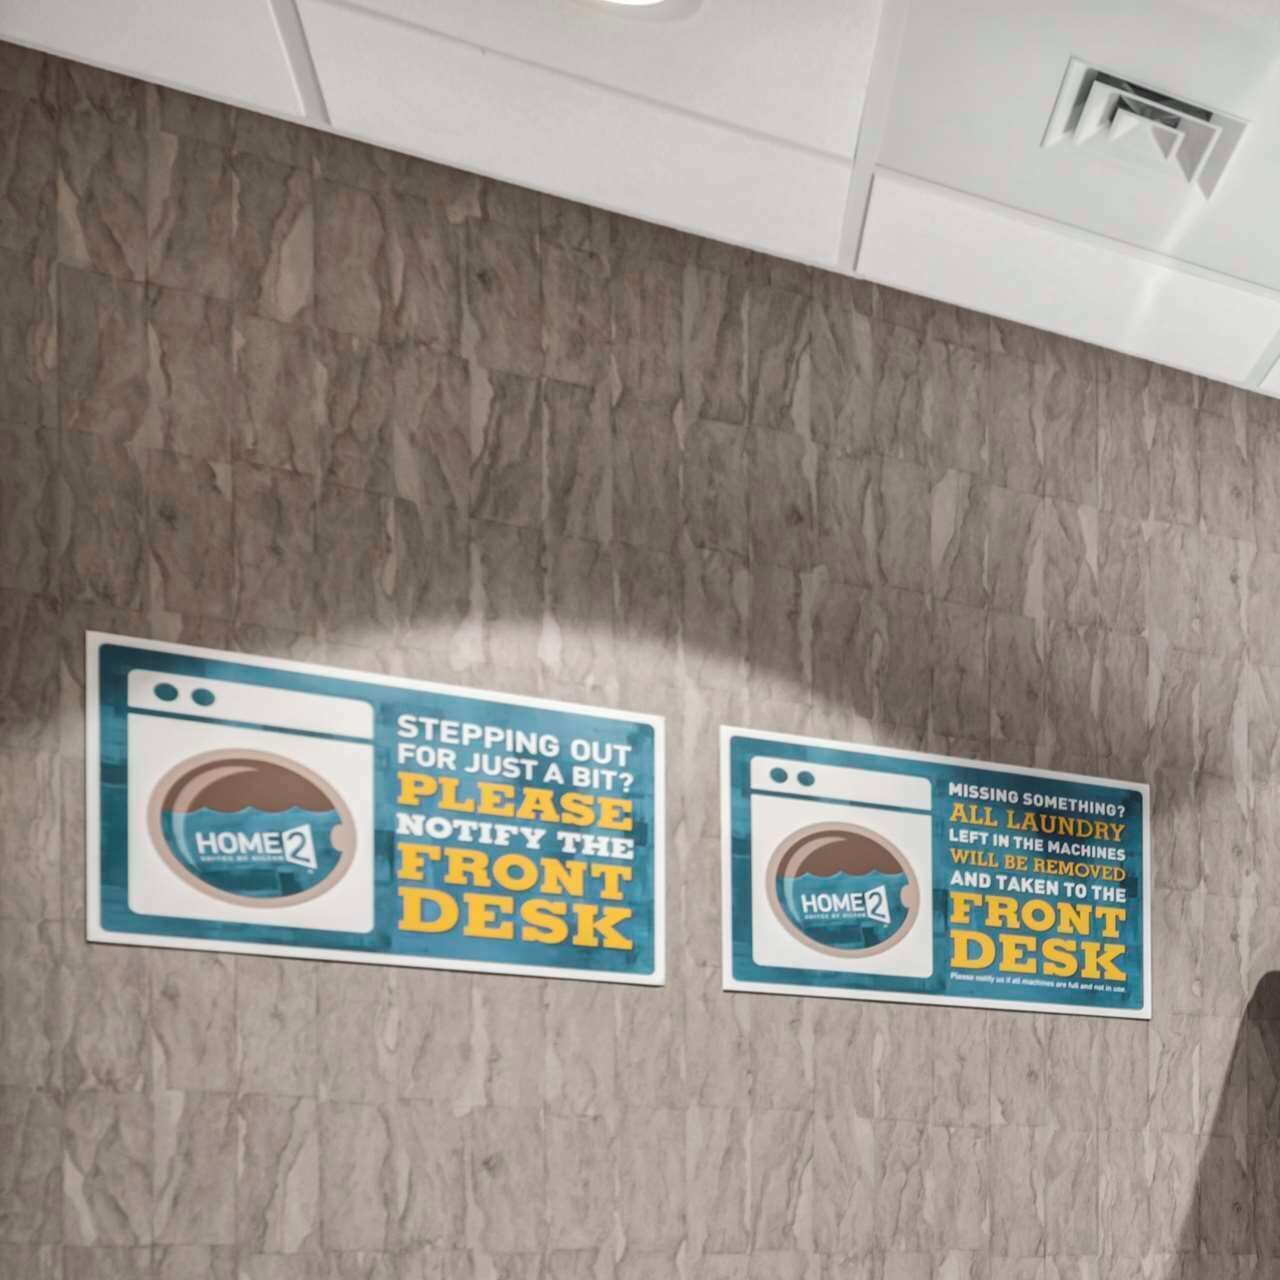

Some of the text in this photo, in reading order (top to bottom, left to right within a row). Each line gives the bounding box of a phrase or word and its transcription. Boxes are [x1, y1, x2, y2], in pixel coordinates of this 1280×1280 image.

[397, 714, 632, 767] STEPPING OUT
[397, 742, 634, 793] FOR JUST A BIT?
[396, 771, 633, 831] PLEASE
[949, 782, 1126, 818] MISSING SOMETHING?
[950, 802, 1126, 842] ALL LAUNDRY
[395, 813, 635, 860] NOTIFY THE
[949, 828, 1126, 861] LEFT IN THE MACHINES
[396, 842, 633, 900] FRONT
[950, 848, 1126, 882] WILL BE REMOVED
[950, 870, 1127, 902] AND TAKEN TO THE
[397, 886, 633, 950] DESK
[949, 891, 1126, 938] FRONT
[950, 929, 1127, 981] DESK
[950, 972, 974, 981] Please
[975, 974, 995, 984] notify
[1022, 977, 1054, 987] machines
[1080, 982, 1093, 990] and
